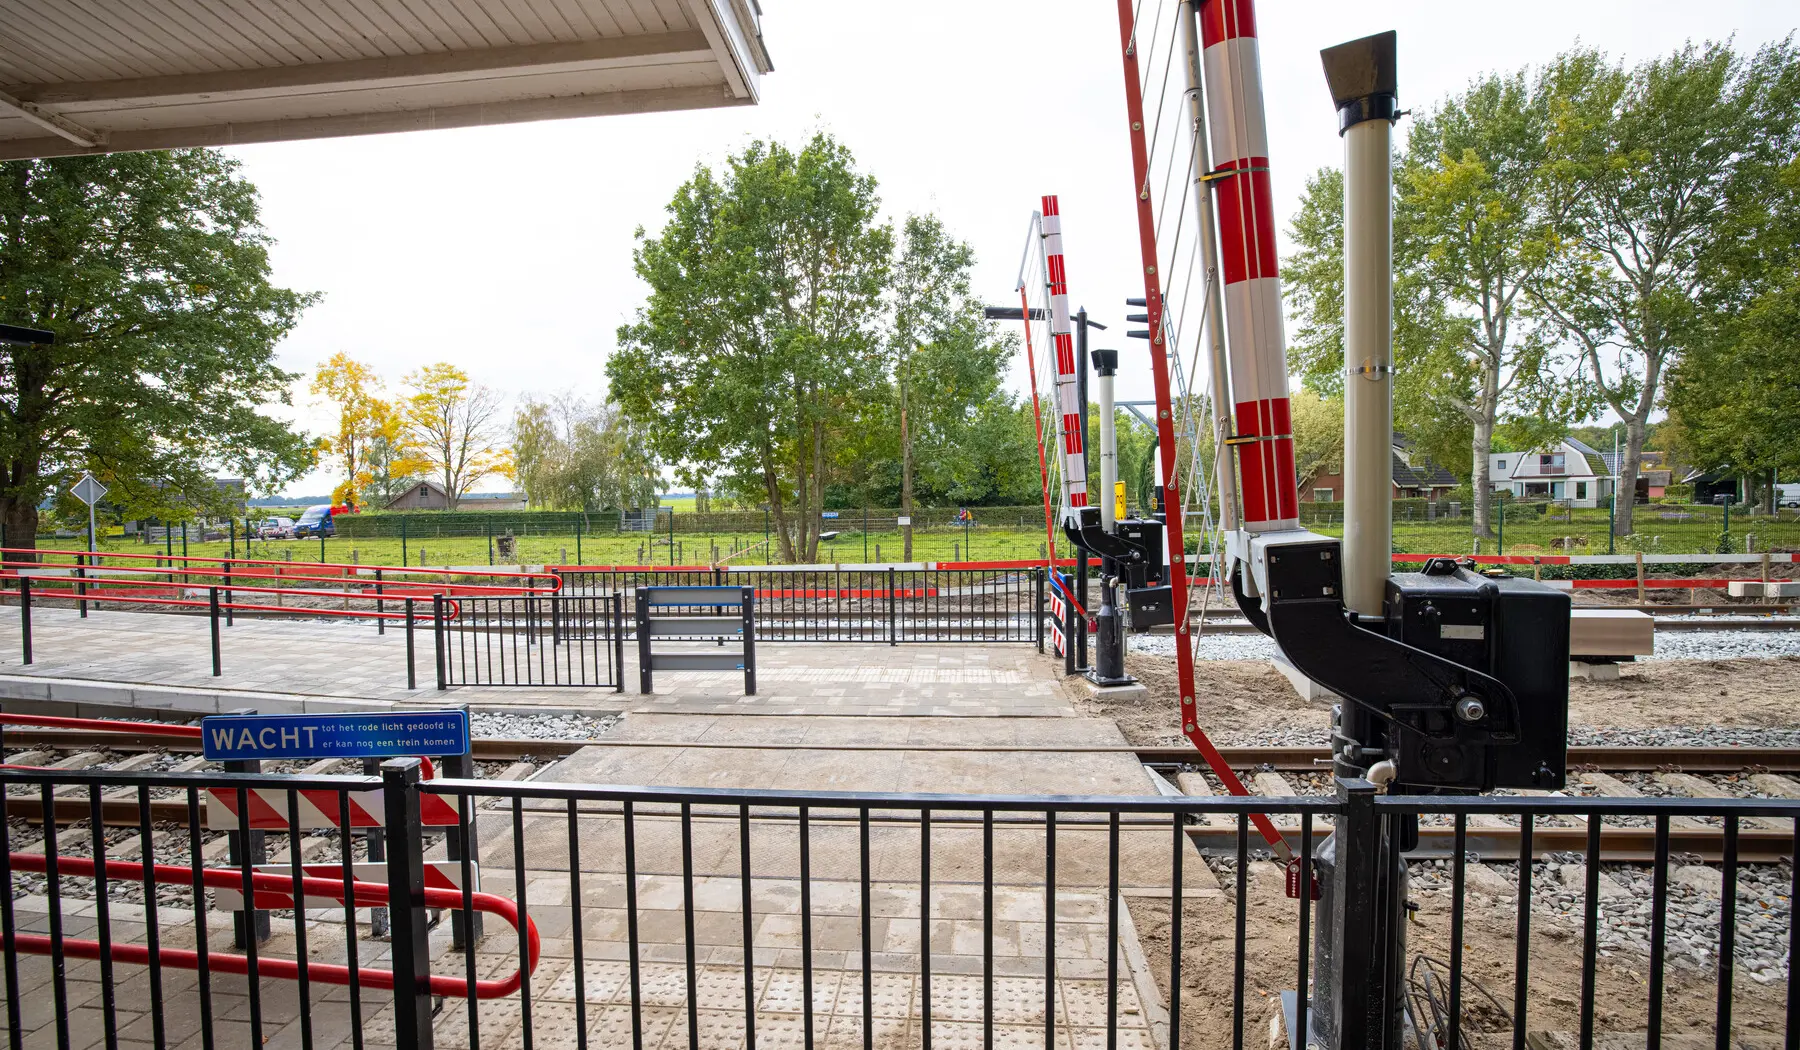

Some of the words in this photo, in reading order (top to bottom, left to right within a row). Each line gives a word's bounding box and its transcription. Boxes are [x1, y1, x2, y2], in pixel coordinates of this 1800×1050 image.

[321, 724, 335, 732] tot
[339, 724, 354, 732] het
[358, 723, 379, 731] rode
[382, 722, 404, 731] licht
[406, 721, 444, 733] gedoofd
[447, 721, 456, 730] is
[211, 726, 319, 751] WACHT
[335, 740, 353, 748] kan
[356, 740, 374, 749] nog
[376, 739, 394, 747] een
[397, 738, 420, 747] trein
[423, 738, 455, 746] komen
